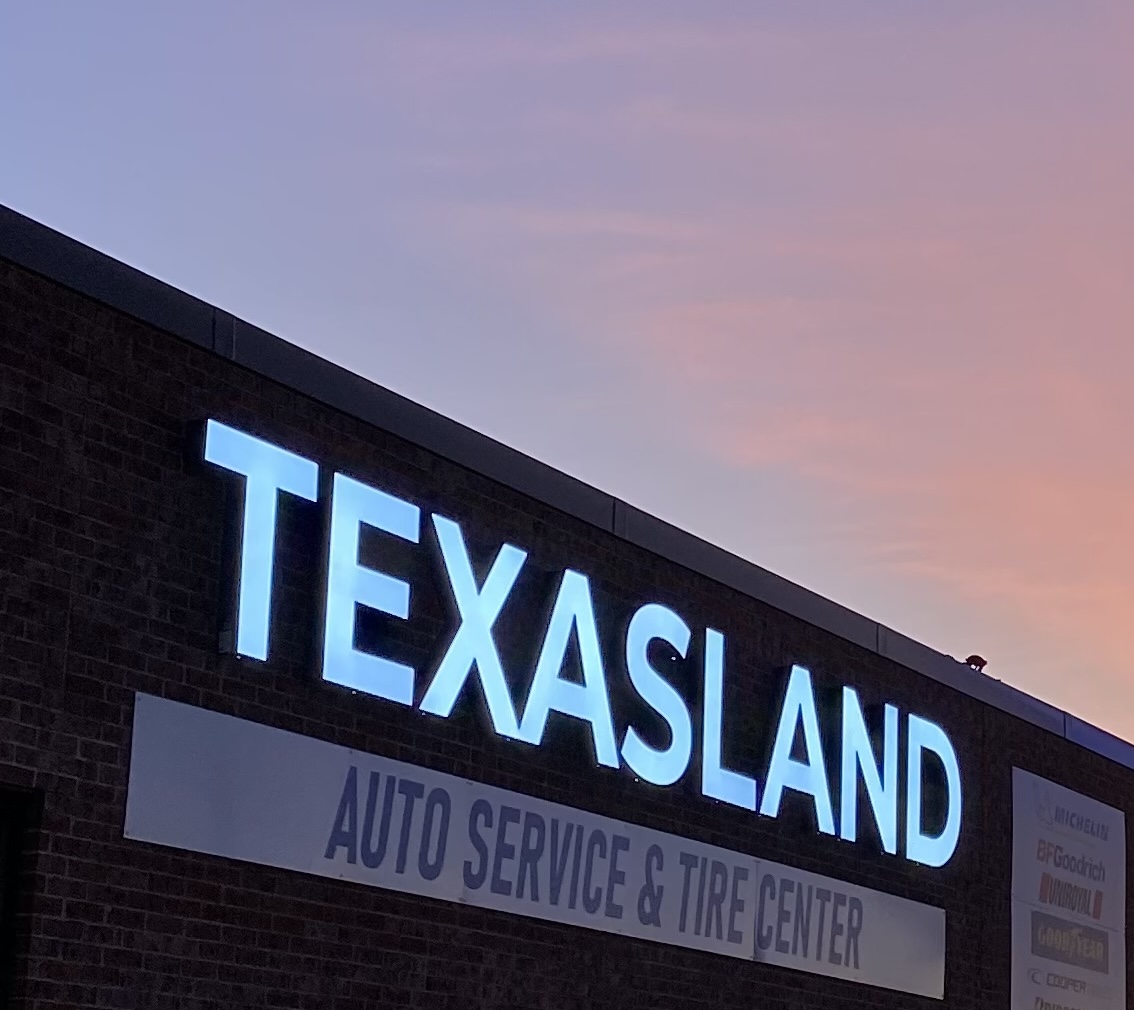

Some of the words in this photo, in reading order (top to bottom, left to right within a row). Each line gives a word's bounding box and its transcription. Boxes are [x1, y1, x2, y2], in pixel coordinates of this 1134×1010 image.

[205, 419, 962, 867] TEXASLAND
[1055, 806, 1109, 841] MICHELIN
[324, 766, 451, 881] AUTO
[463, 799, 630, 919] SERVICE
[638, 844, 664, 927] &
[679, 852, 749, 944] TIRE
[757, 873, 863, 969] CENTER
[1037, 839, 1105, 882] BFGoodrich
[1049, 876, 1092, 915] UNIROYAL
[1046, 973, 1087, 994] COOPER
